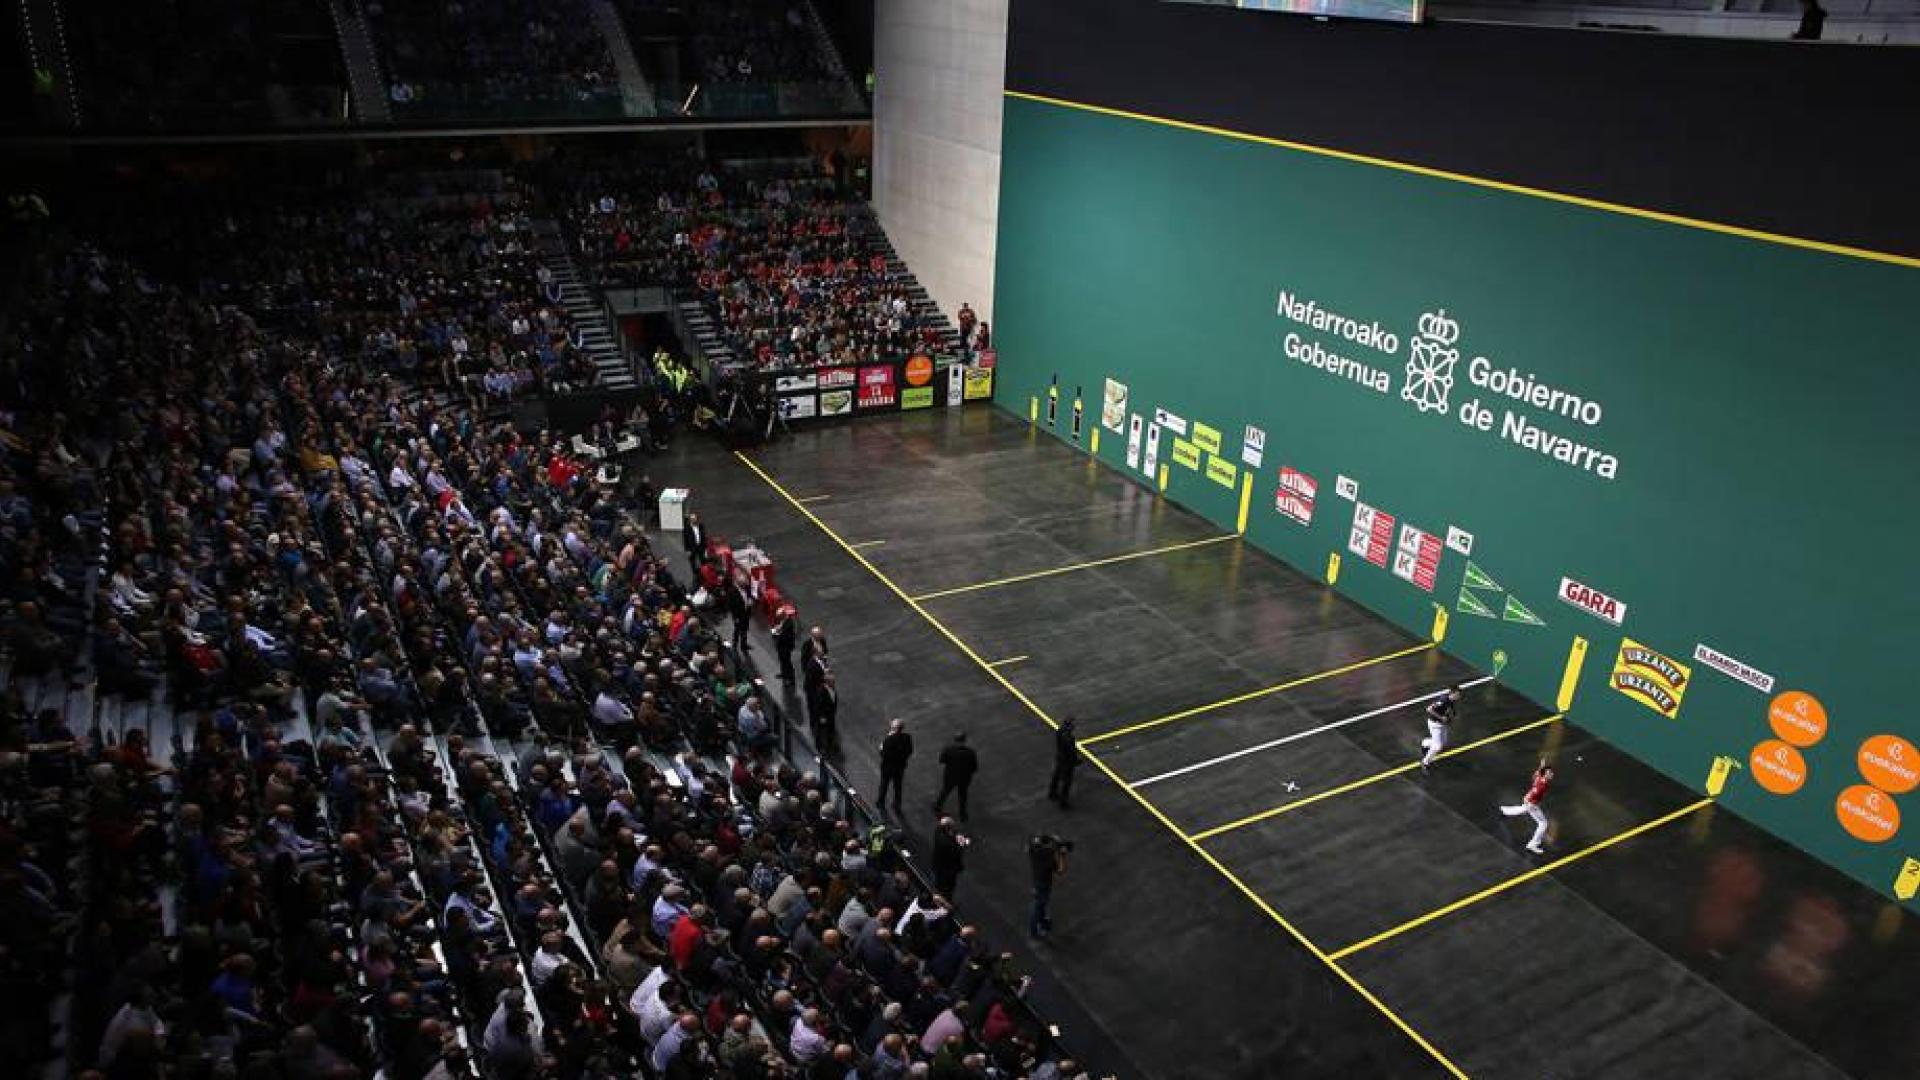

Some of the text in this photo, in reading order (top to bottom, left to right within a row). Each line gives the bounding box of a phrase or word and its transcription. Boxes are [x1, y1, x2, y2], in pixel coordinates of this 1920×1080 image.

[1277, 290, 1399, 354] Nafarroako
[1284, 333, 1391, 393] Gobernua
[1469, 356, 1602, 425] Gobierno
[1459, 399, 1619, 480] de Navarra
[1566, 582, 1617, 619] GARA
[1707, 651, 1740, 675] DIARIO
[1740, 667, 1770, 688] VASCO
